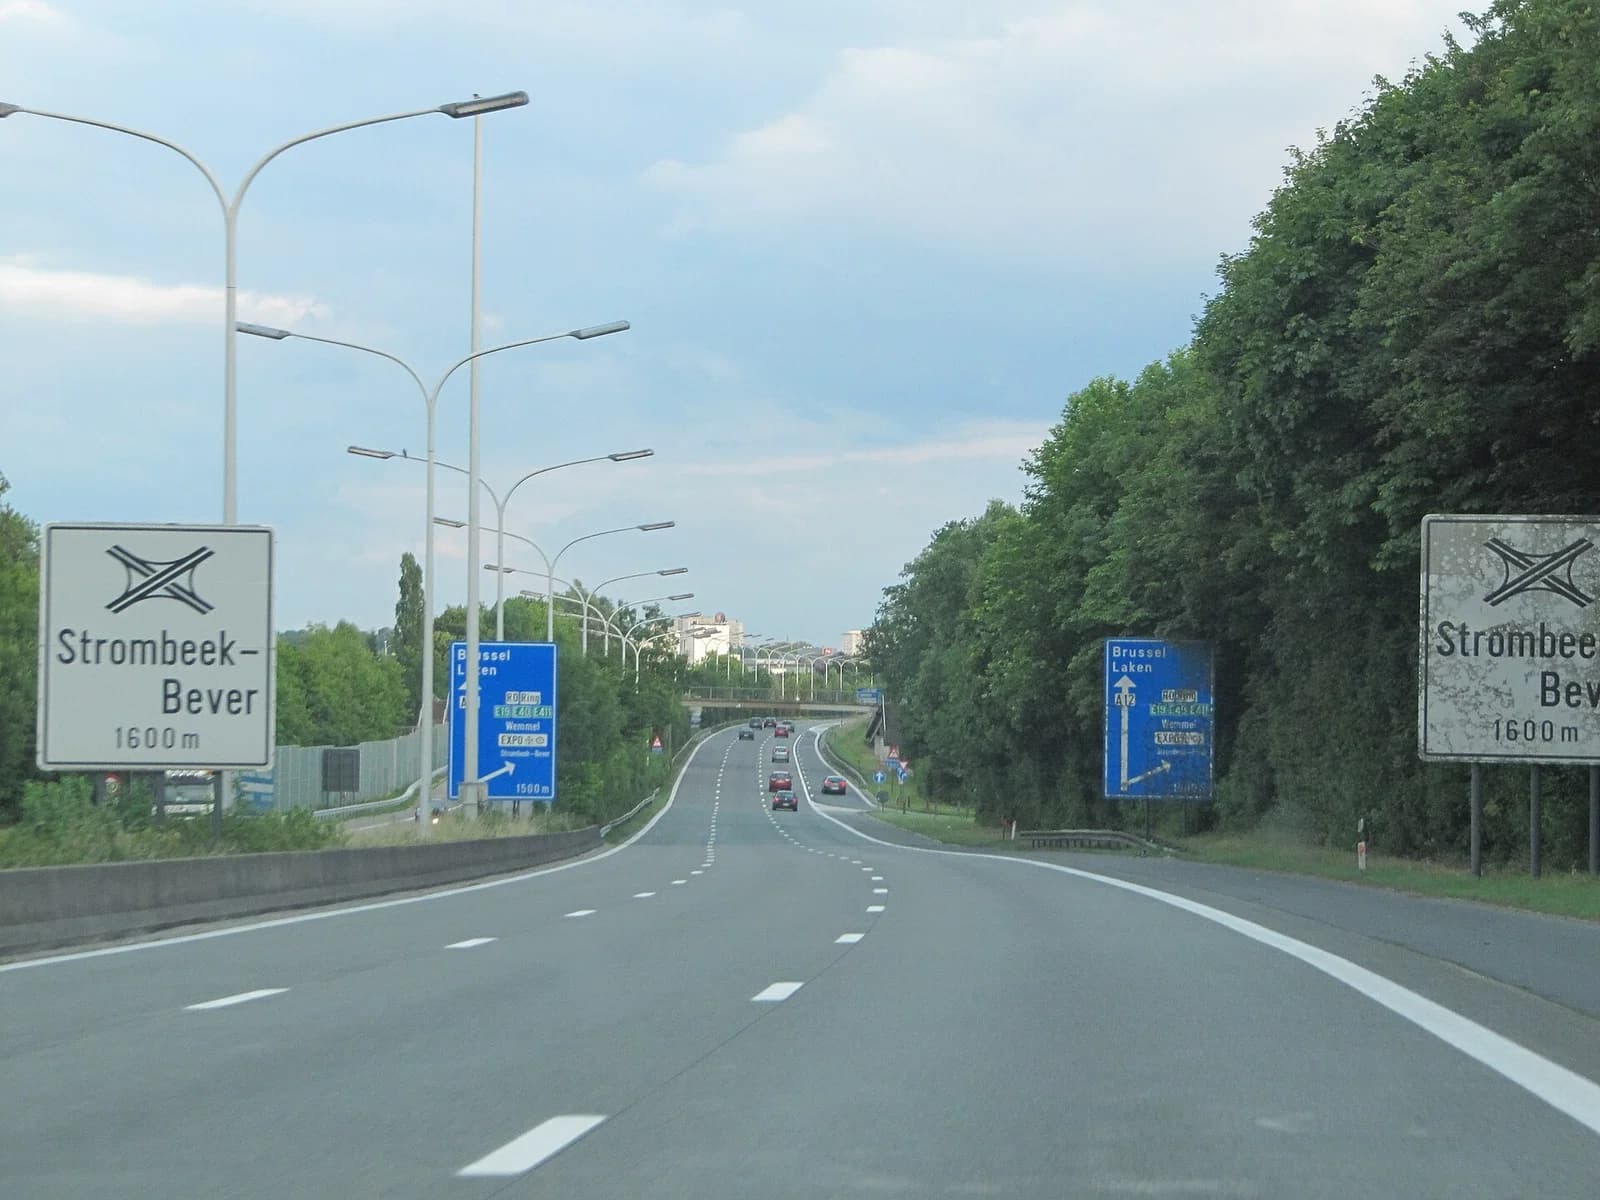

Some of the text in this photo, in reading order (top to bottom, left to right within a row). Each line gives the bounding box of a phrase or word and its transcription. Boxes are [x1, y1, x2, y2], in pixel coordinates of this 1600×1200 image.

[457, 648, 511, 661] Bssel
[1112, 646, 1166, 658] Brussel
[457, 663, 497, 676] Len
[1112, 661, 1152, 673] Laken
[162, 679, 259, 715] Bever
[1115, 694, 1136, 705] A12
[505, 721, 541, 731] Wemmel
